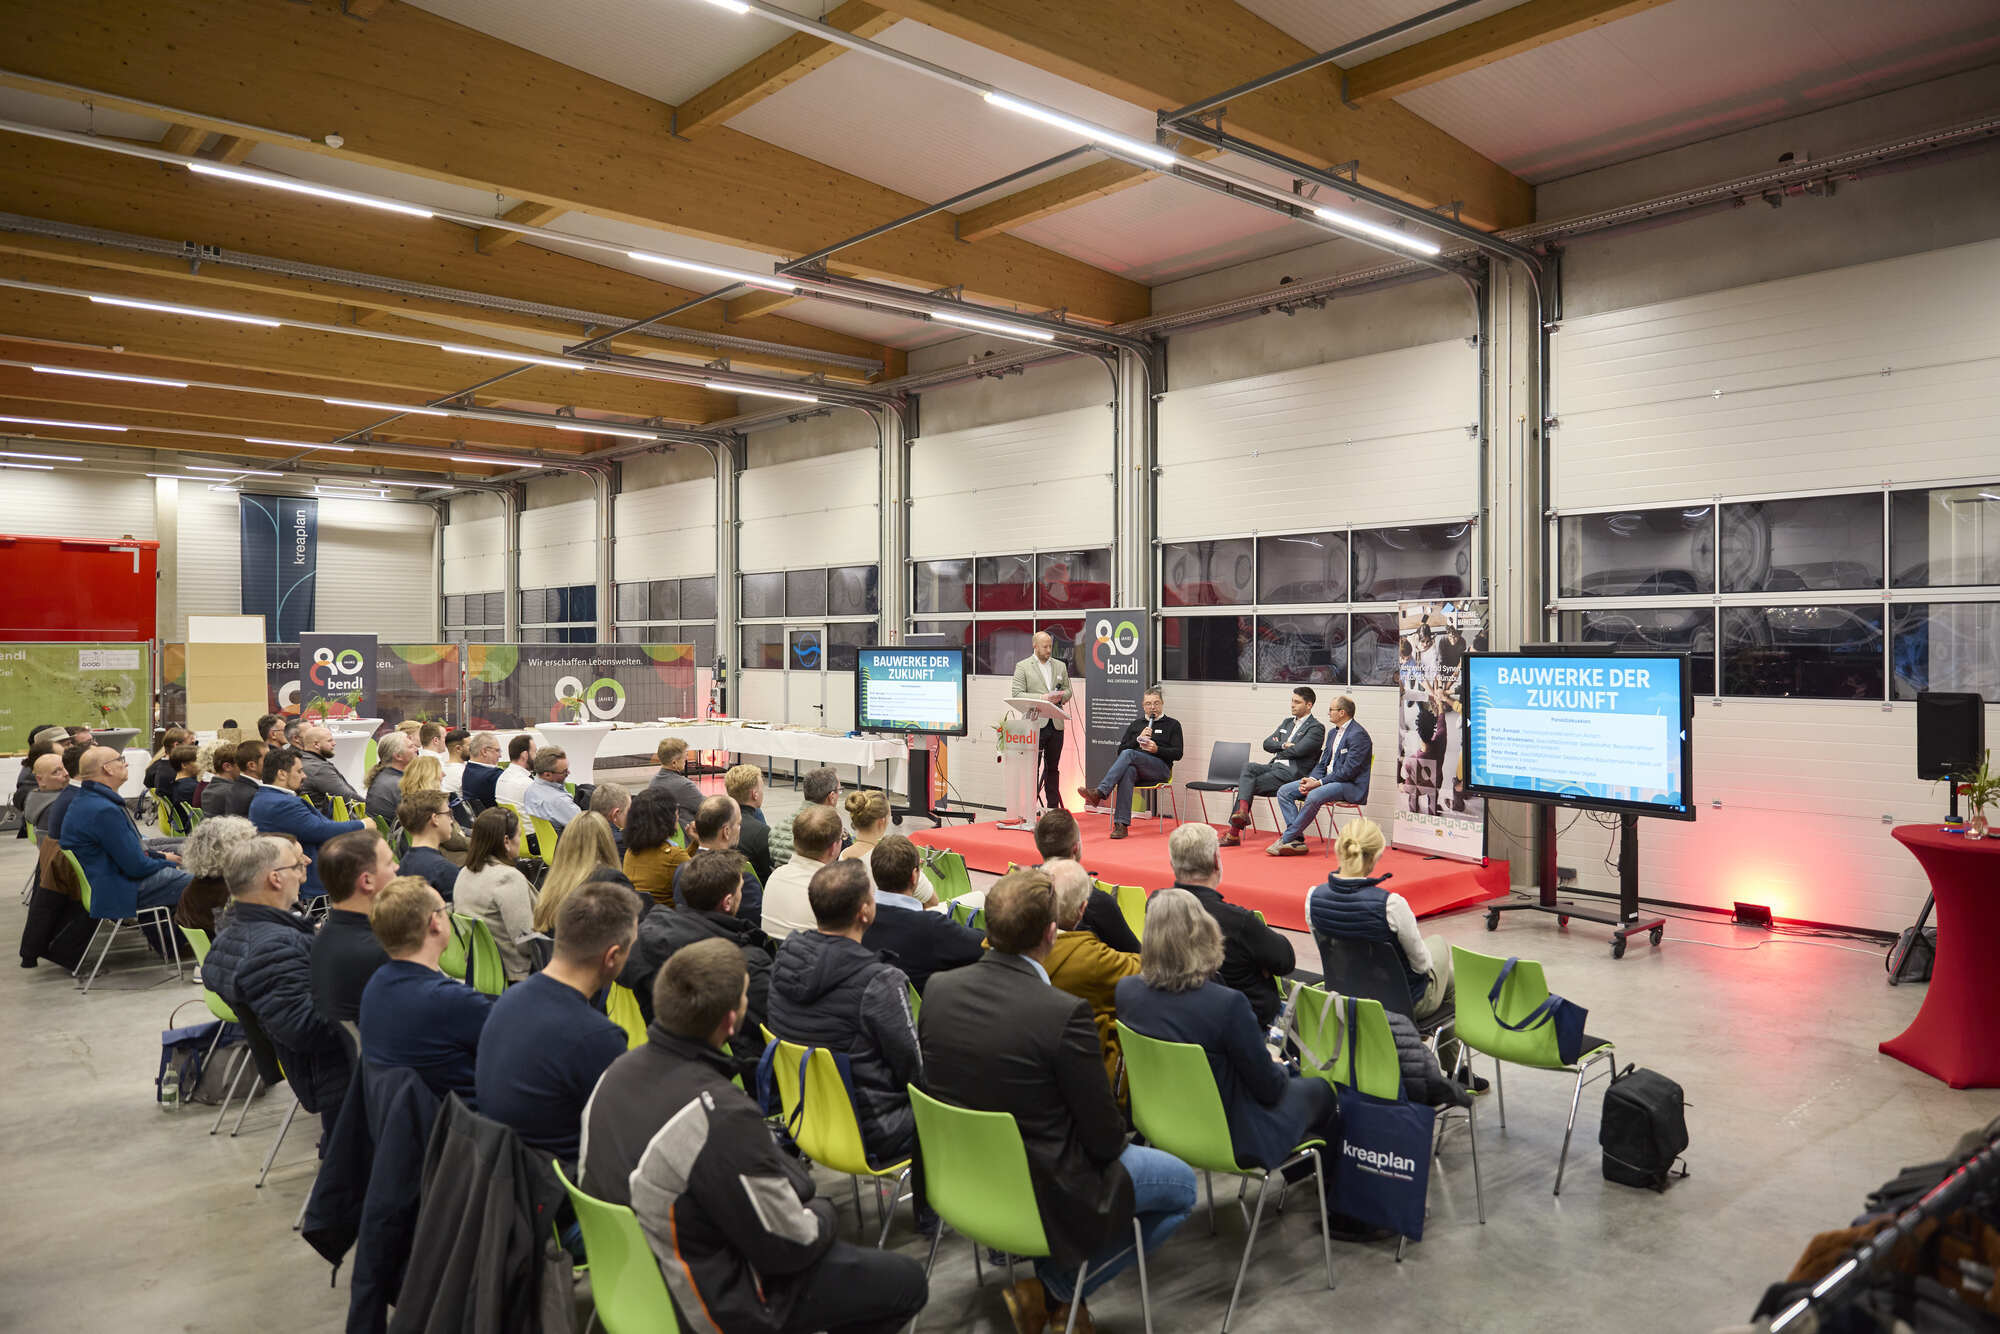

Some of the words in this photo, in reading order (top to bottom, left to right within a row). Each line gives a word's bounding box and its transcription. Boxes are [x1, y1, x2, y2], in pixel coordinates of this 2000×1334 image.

[293, 510, 308, 565] kreaplan
[0, 650, 26, 661] endl
[528, 658, 543, 667] Wir
[545, 658, 587, 666] erschaffen
[588, 657, 643, 666] Lebenswelten.
[873, 655, 928, 667] BAUWERKE
[929, 656, 950, 668] DER
[266, 660, 300, 669] erscha
[1107, 658, 1139, 675] bendl
[888, 668, 935, 680] ZUKUNFT
[1497, 667, 1604, 687] BAUWERKE
[1609, 668, 1650, 688] DER
[327, 676, 363, 689] bendl
[1527, 689, 1619, 711] ZUKUNFT
[1005, 728, 1036, 745] bendl
[1343, 1139, 1416, 1172] kreaplan
